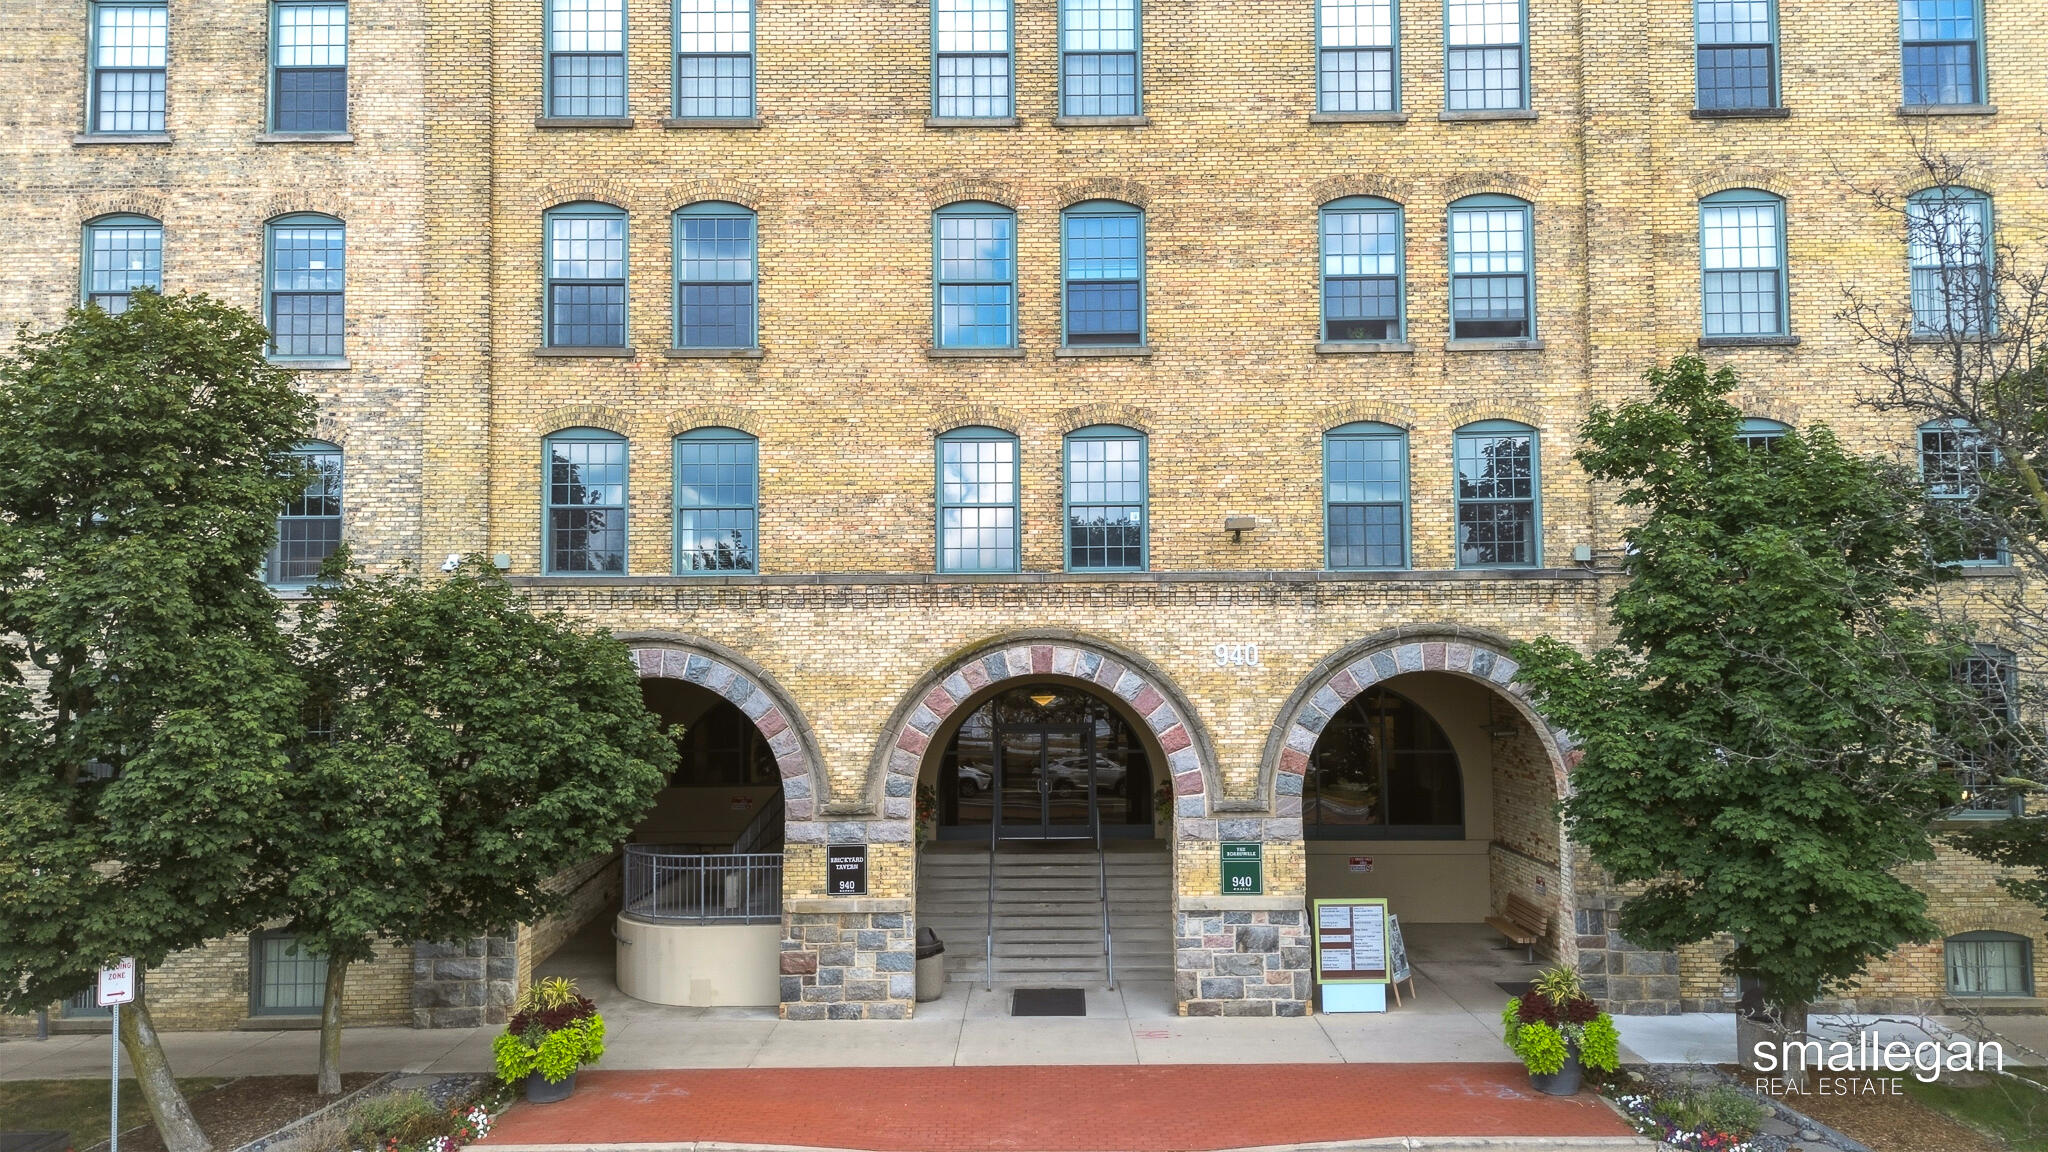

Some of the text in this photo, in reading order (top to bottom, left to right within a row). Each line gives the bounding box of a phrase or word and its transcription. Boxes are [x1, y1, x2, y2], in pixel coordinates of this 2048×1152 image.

[1215, 643, 1259, 667] 940
[839, 880, 855, 890] 940
[1232, 876, 1252, 887] 940
[108, 972, 126, 981] ZONE
